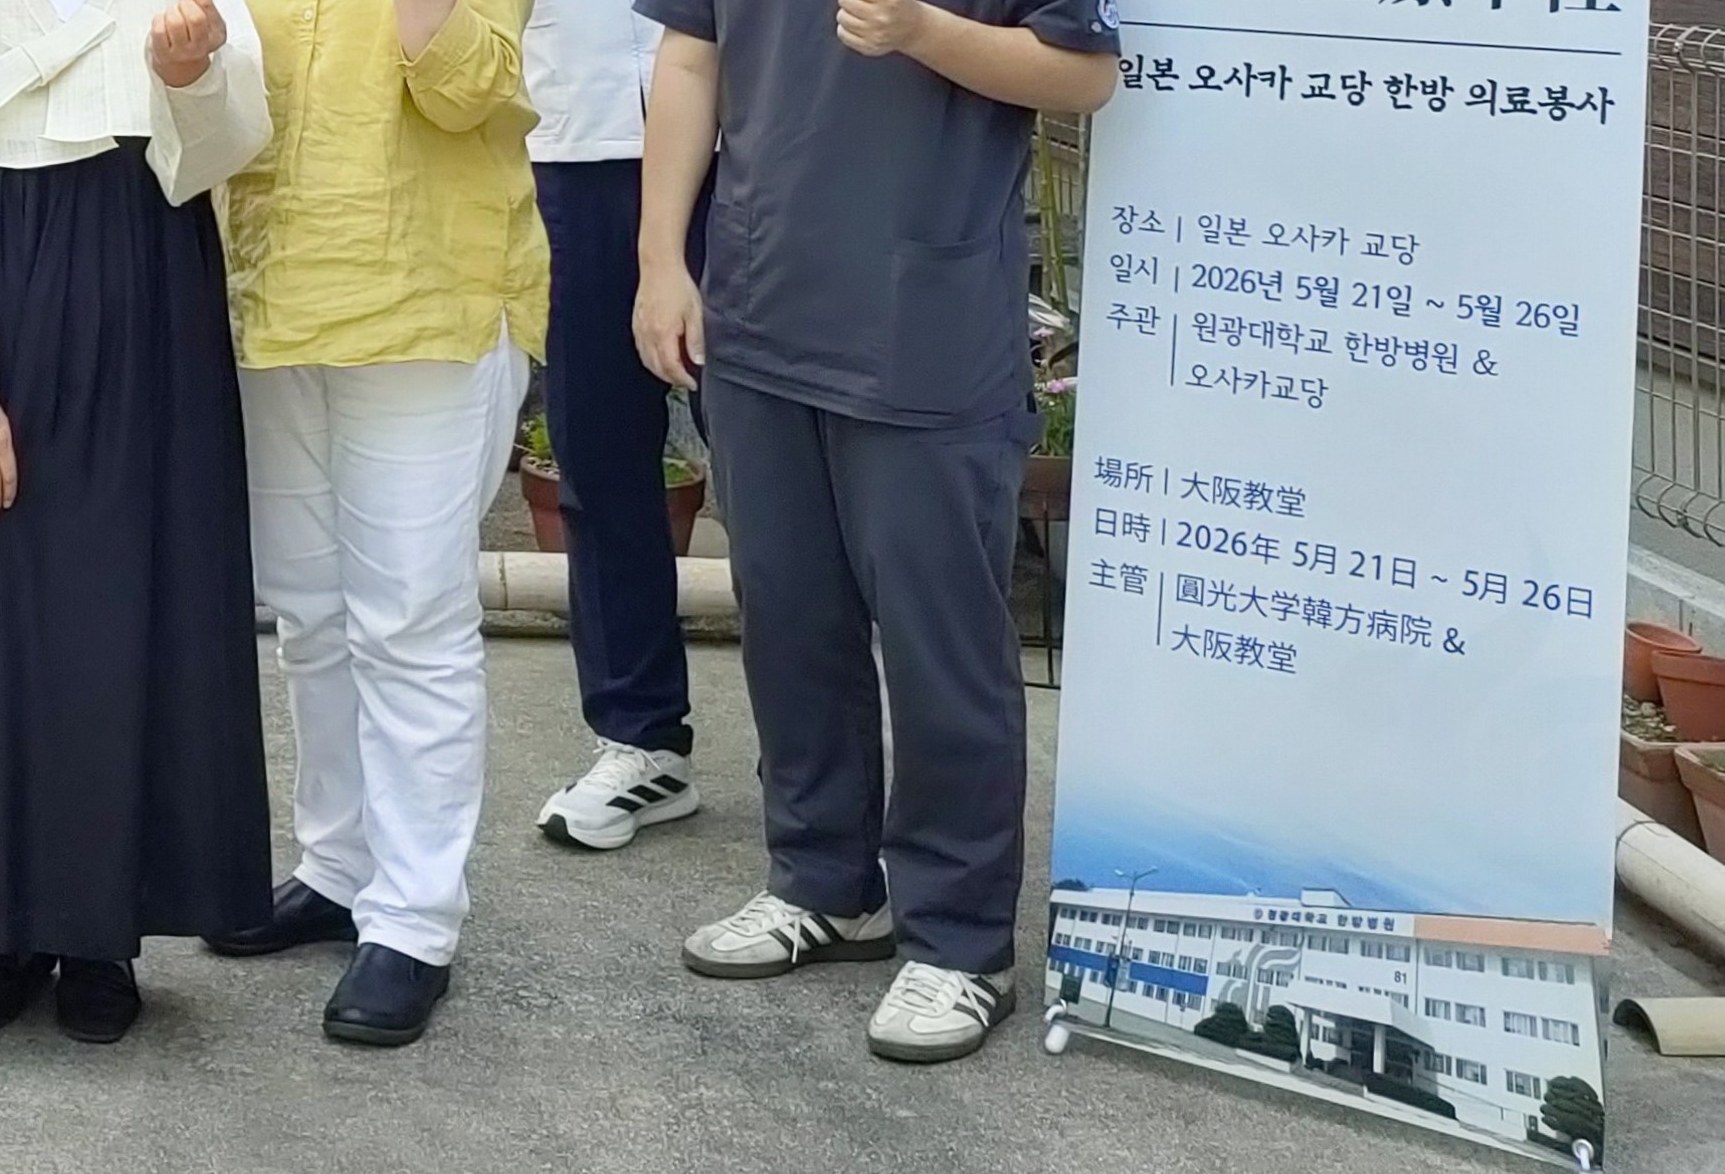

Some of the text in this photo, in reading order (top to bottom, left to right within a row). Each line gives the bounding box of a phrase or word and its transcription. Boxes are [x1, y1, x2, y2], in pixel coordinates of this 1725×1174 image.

[1118, 53, 1616, 126] 일본 오사카 교당 한방 의료봉사
[1109, 204, 1421, 266] 장소 일본 오사카 교당
[1108, 253, 1160, 285] 일시
[1190, 262, 1284, 304] 2026년
[1295, 274, 1340, 309] 5월
[1351, 281, 1414, 319] 21일
[1456, 293, 1503, 330] 5월
[1515, 299, 1581, 337] 26일
[1105, 301, 1499, 377] 주관 원광대학교 한방병원 &
[1184, 363, 1330, 410] 오사카교당
[1093, 455, 1308, 519] 場所 大阪教堂
[1093, 507, 1152, 545] 日時
[1176, 522, 1281, 566] 2026年
[1292, 540, 1339, 576] 5月
[1349, 549, 1418, 590] 21日
[1461, 569, 1509, 606] 5月
[1521, 579, 1595, 620] 26日
[1089, 559, 1150, 597] 主管
[1442, 627, 1468, 656] &
[1170, 623, 1299, 676] 大阪教堂
[1393, 970, 1408, 985] 81
